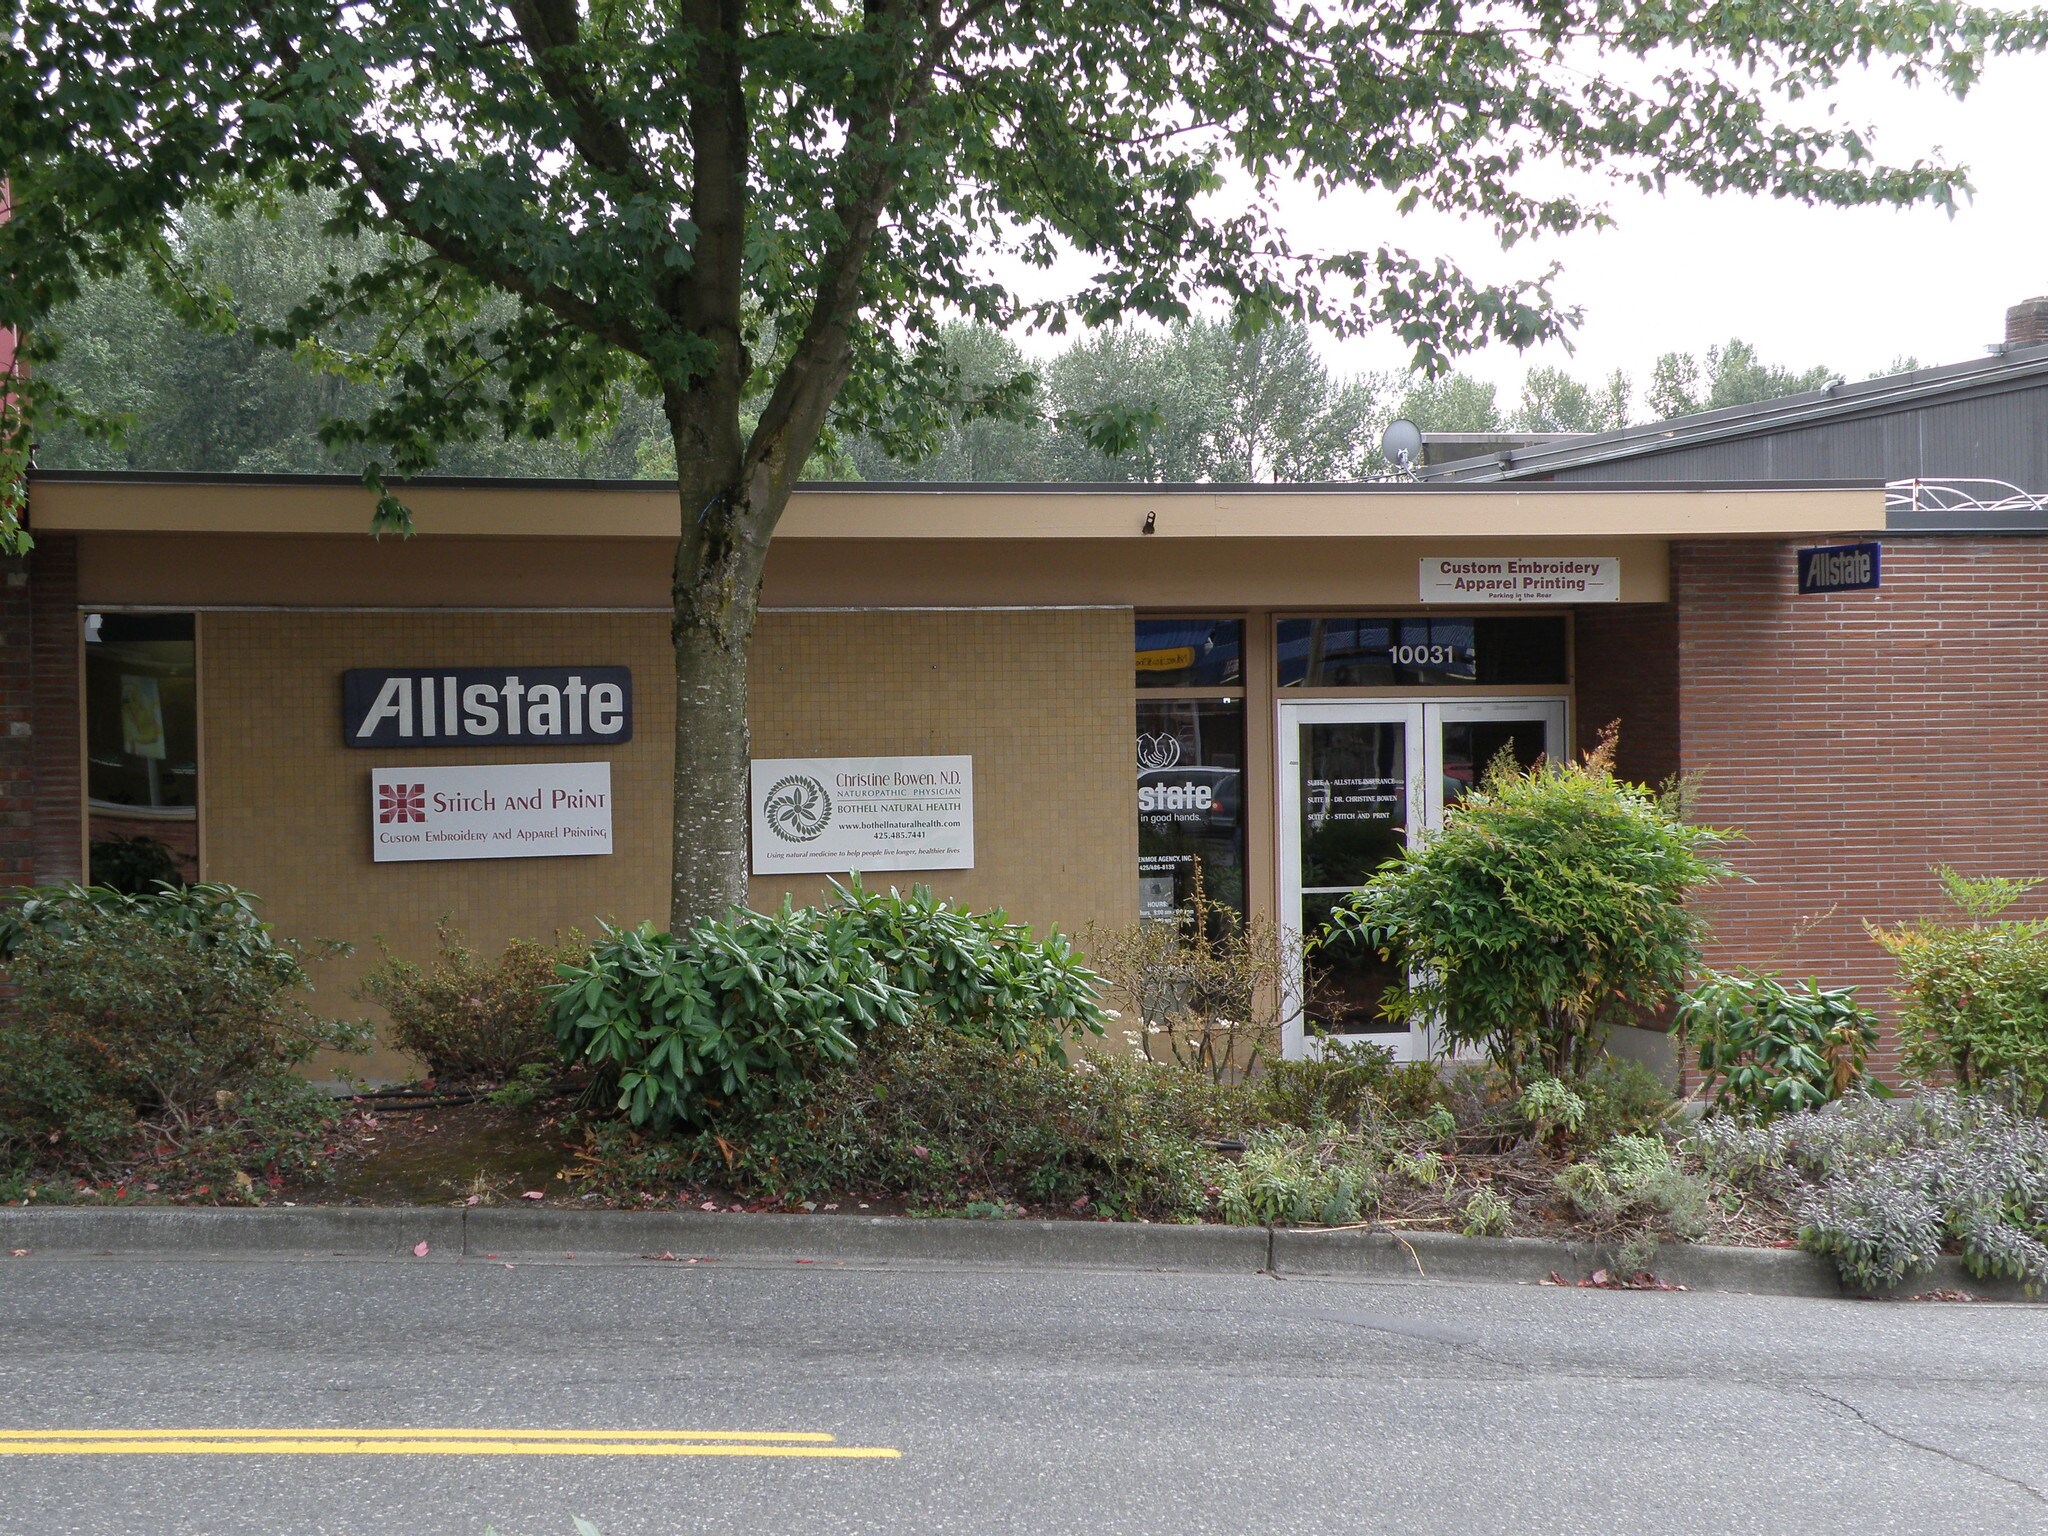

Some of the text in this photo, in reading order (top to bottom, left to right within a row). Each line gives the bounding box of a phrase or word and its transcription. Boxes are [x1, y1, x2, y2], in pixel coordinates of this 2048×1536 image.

[1440, 561, 1600, 576] Custom Embroidery
[1805, 549, 1871, 587] Allstate
[1454, 577, 1586, 592] Apparel Printing
[1388, 645, 1454, 664] 10031
[356, 676, 624, 738] Allstate
[836, 773, 890, 787] Christine
[940, 771, 961, 785] N.D.
[432, 788, 606, 813] Stitch and Print
[837, 789, 907, 797] NATUROPATHIC
[837, 803, 961, 813] BOTHELL NATURAL HEALTH
[838, 820, 961, 830] www.bothellnaturalhealth.com
[1140, 812, 1202, 824] in good hands.
[379, 826, 607, 843] Custom Embroidery and Apparel Printing
[873, 831, 926, 839] 425.485.7441
[766, 852, 785, 860] Using
[847, 849, 860, 858] help
[861, 848, 882, 858] people
